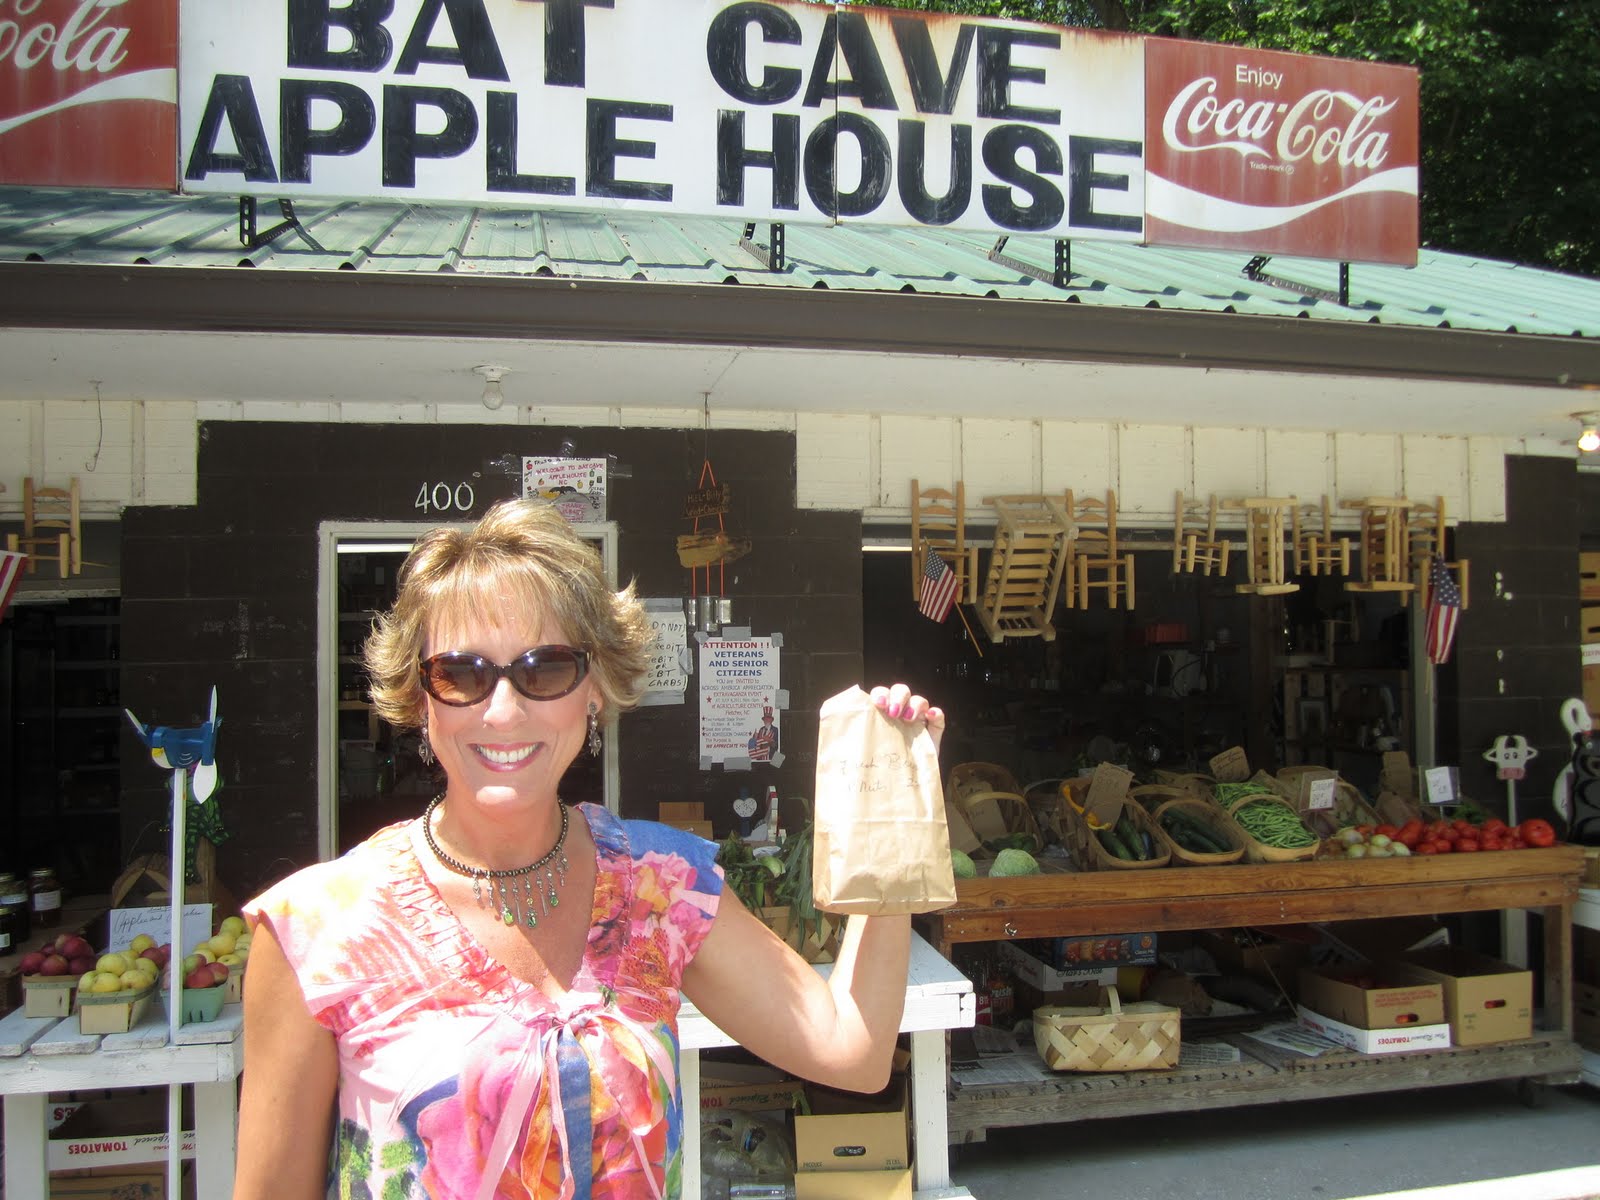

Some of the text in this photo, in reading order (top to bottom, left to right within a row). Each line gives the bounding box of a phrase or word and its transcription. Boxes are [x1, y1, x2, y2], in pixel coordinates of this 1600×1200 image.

[287, 0, 1061, 124] BAT CAVE
[1235, 64, 1283, 89] Enjoy
[1162, 77, 1400, 169] Coca-Cola
[185, 74, 1145, 232] APPLE HOUSE
[414, 481, 474, 514] 400
[1377, 1036, 1410, 1045] TOMATOES
[68, 1141, 128, 1155] TOMATOES
